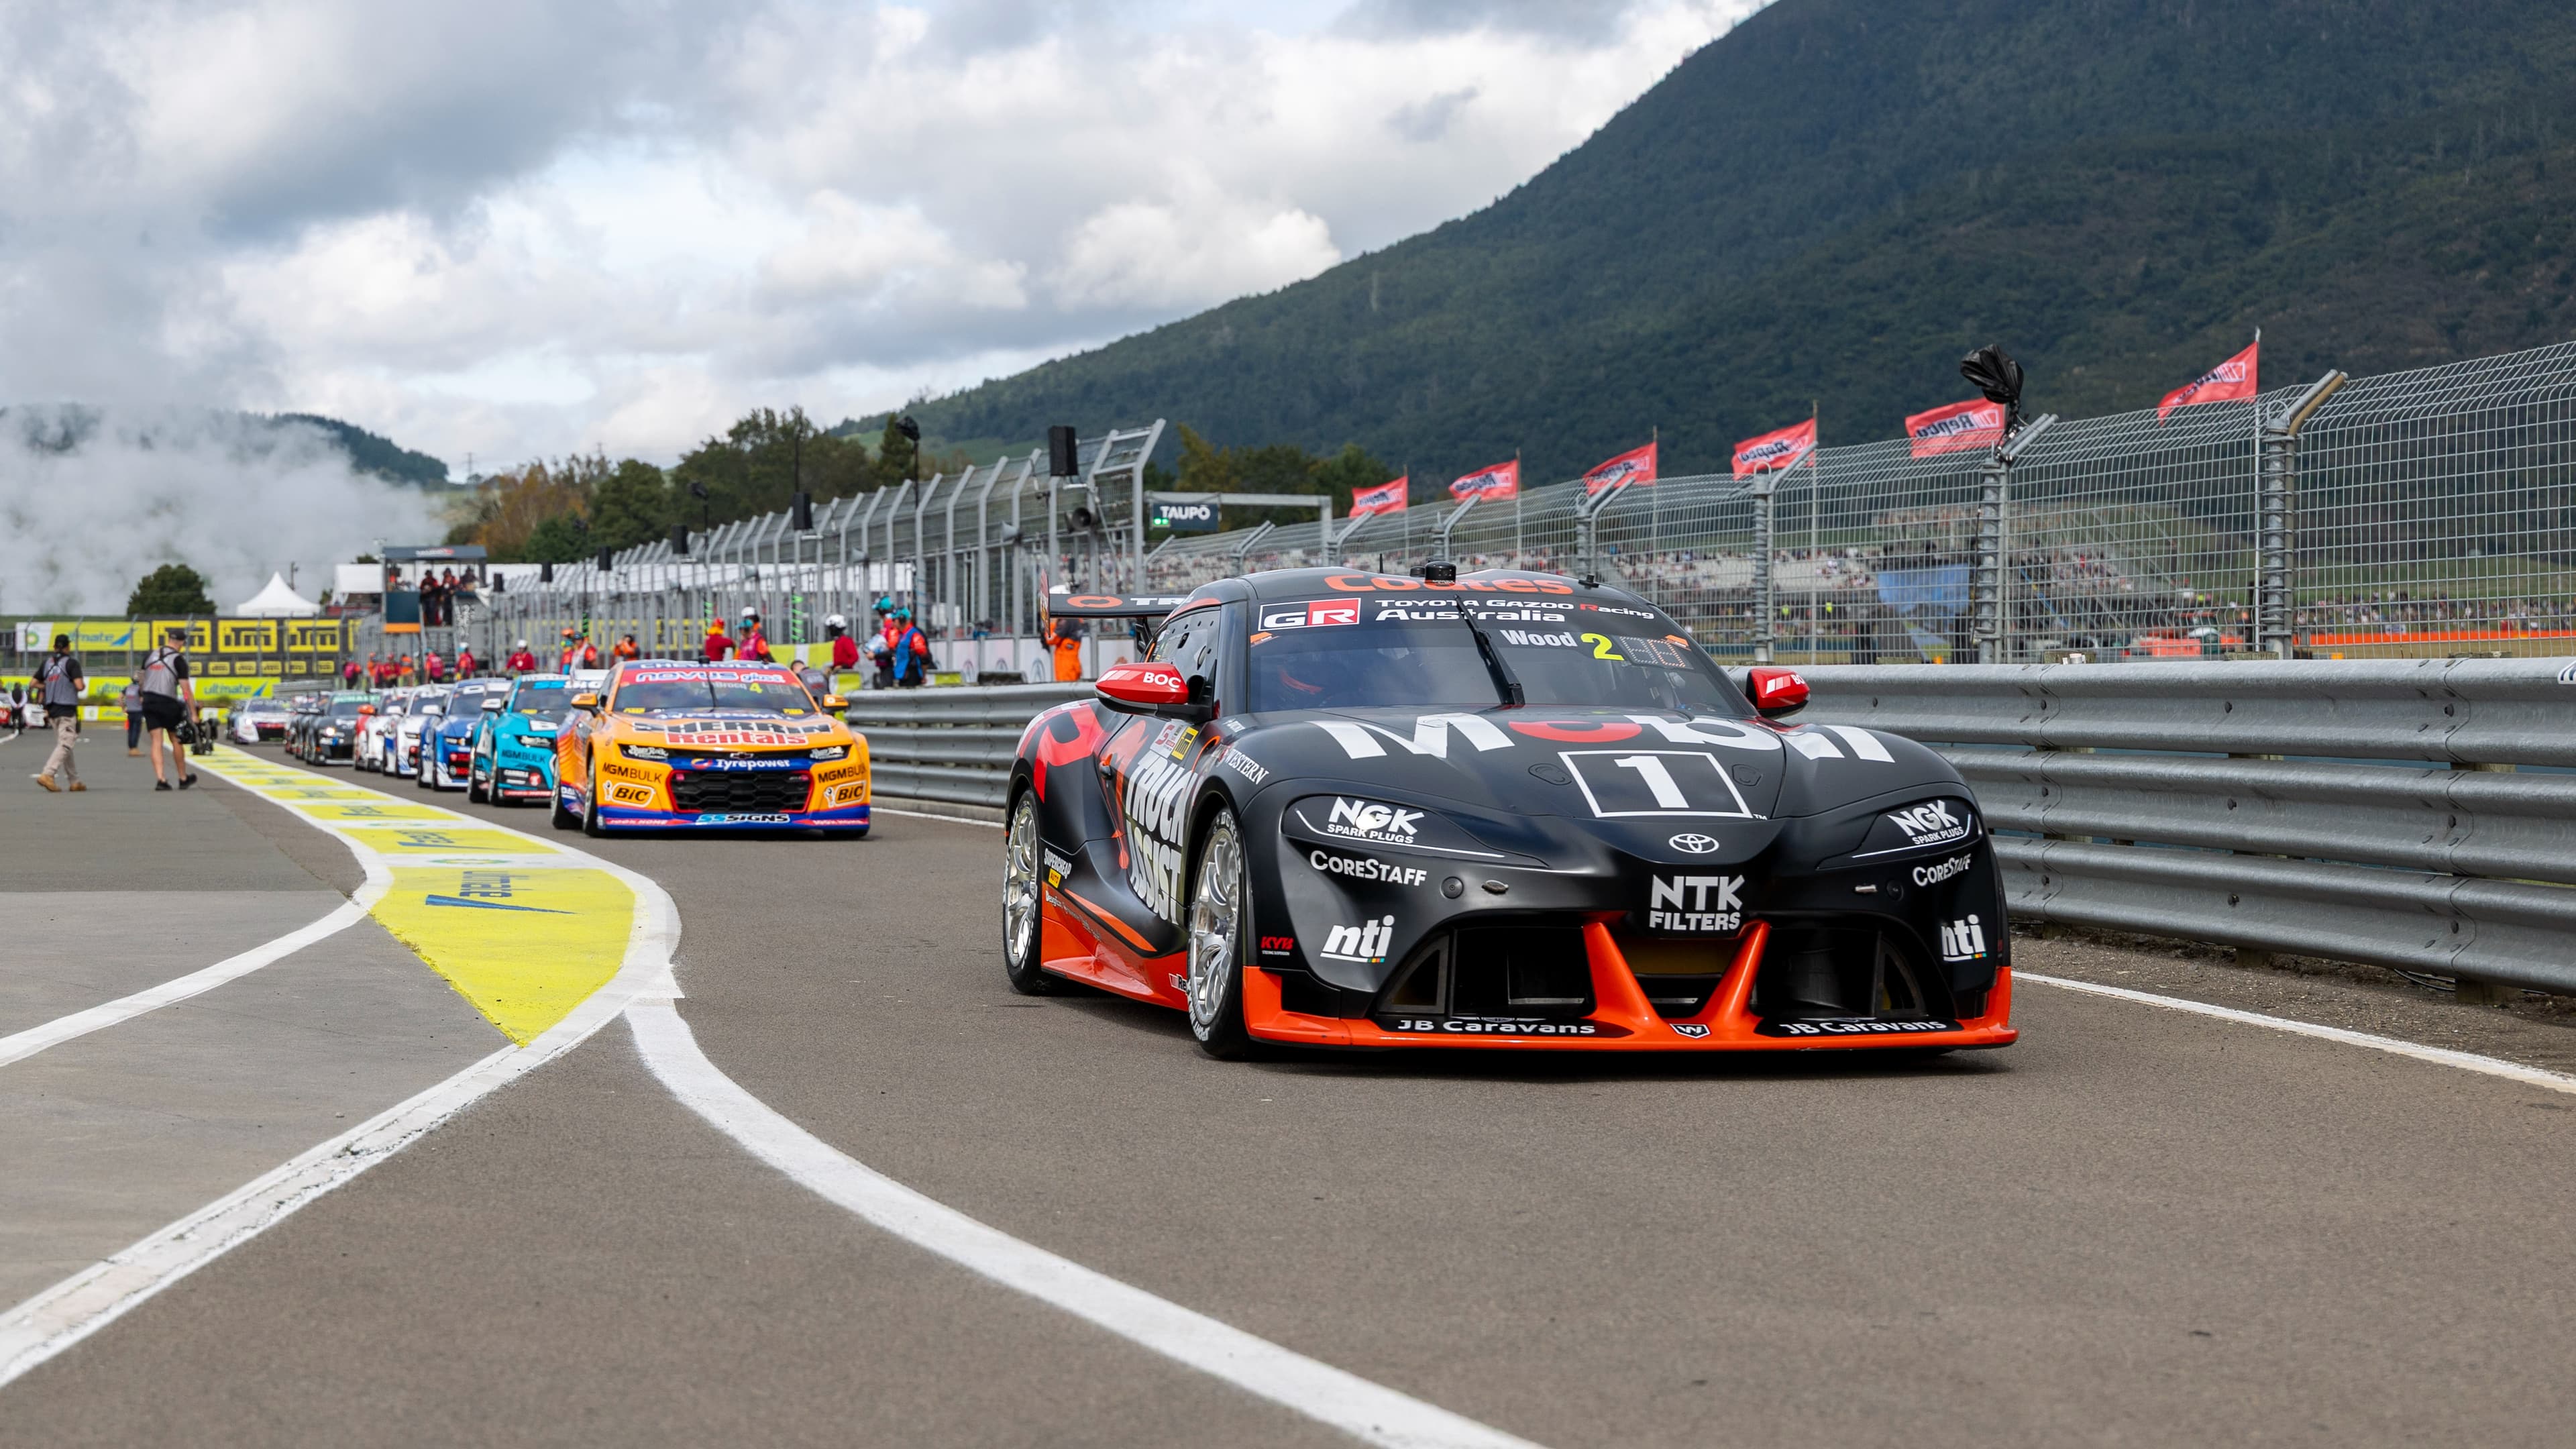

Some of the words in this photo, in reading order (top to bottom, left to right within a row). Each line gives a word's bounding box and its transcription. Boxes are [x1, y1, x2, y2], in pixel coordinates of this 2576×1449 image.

[1159, 504, 1211, 521] TAUPŌ
[1263, 609, 1356, 627] GR
[1375, 599, 1479, 608] TOYOTA
[1486, 599, 1574, 610] GAZOO
[1580, 604, 1654, 620] Racing
[1375, 608, 1565, 622] Australia
[1499, 629, 1578, 647] Wood
[1580, 633, 1625, 661] 2
[203, 683, 251, 694] ultimate
[749, 682, 763, 694] 4
[1142, 672, 1181, 688] BOC
[1790, 674, 1805, 685] BO
[666, 731, 808, 745] Rentals
[715, 759, 790, 771] Tyrepower
[1224, 748, 1270, 786] WESTERN
[1305, 713, 1894, 763] Mobil
[1614, 755, 1690, 809] 1
[1125, 750, 1201, 847] TRUCK
[1328, 796, 1425, 836] NGK
[1886, 799, 1960, 837] NGK
[1327, 823, 1368, 838] SPARK
[1369, 830, 1415, 845] PLUGS
[1912, 831, 1941, 845] SPARK
[1942, 826, 1964, 839] PLUGS
[1650, 874, 1746, 910] NTK
[1649, 910, 1741, 932] FILTERS
[1260, 936, 1294, 949] KYB
[1322, 914, 1395, 958] nti
[1941, 914, 1986, 957] nti
[1398, 1020, 1434, 1031] JB
[1442, 1020, 1596, 1034] Caravans
[1780, 1022, 1815, 1035] JB
[1819, 1018, 1947, 1034] Caravans
